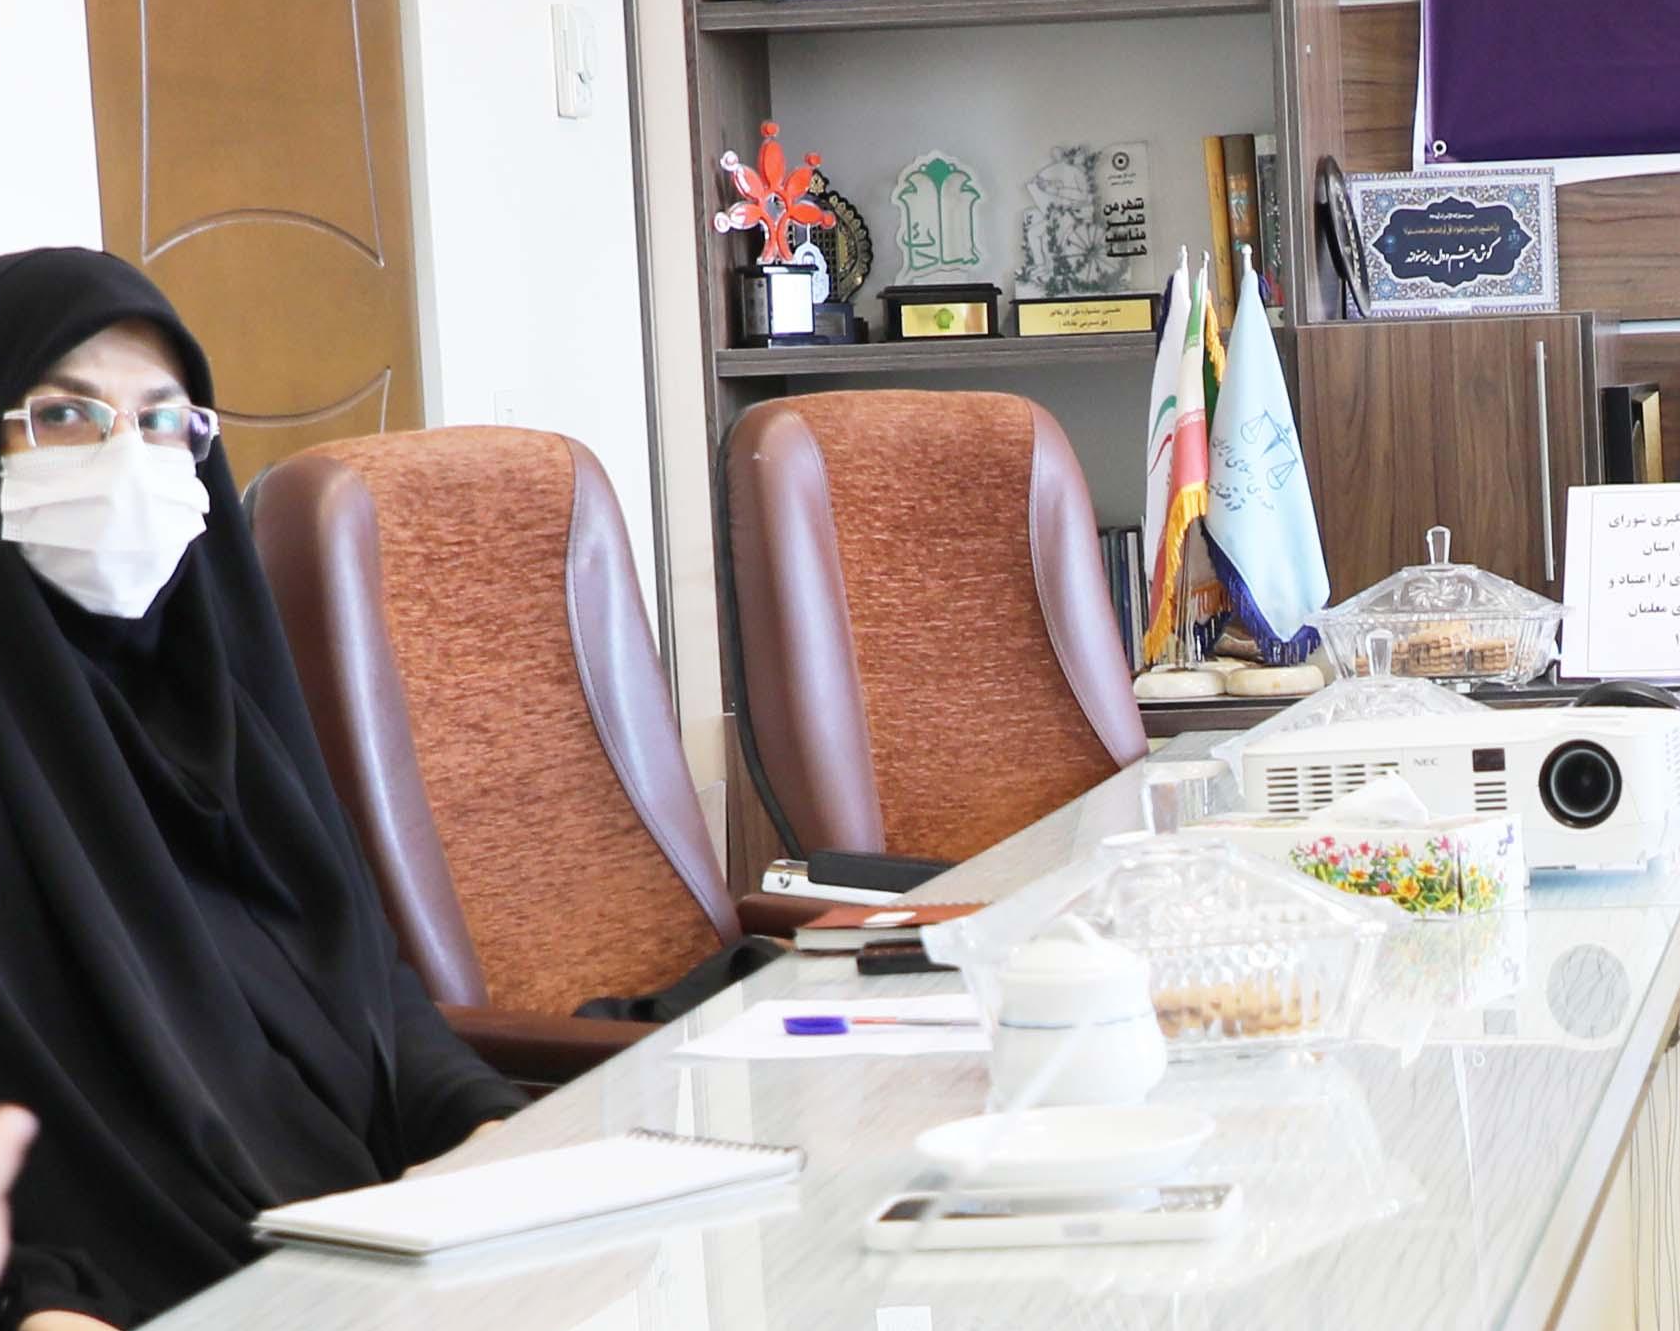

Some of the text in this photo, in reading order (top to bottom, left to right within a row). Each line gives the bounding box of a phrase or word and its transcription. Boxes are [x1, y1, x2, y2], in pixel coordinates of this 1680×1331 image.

[1608, 514, 1647, 529] شورای
[1642, 541, 1676, 557] استان
[1655, 573, 1666, 588] از
[1628, 602, 1667, 618] معلمان
[1413, 757, 1439, 766] NEC
